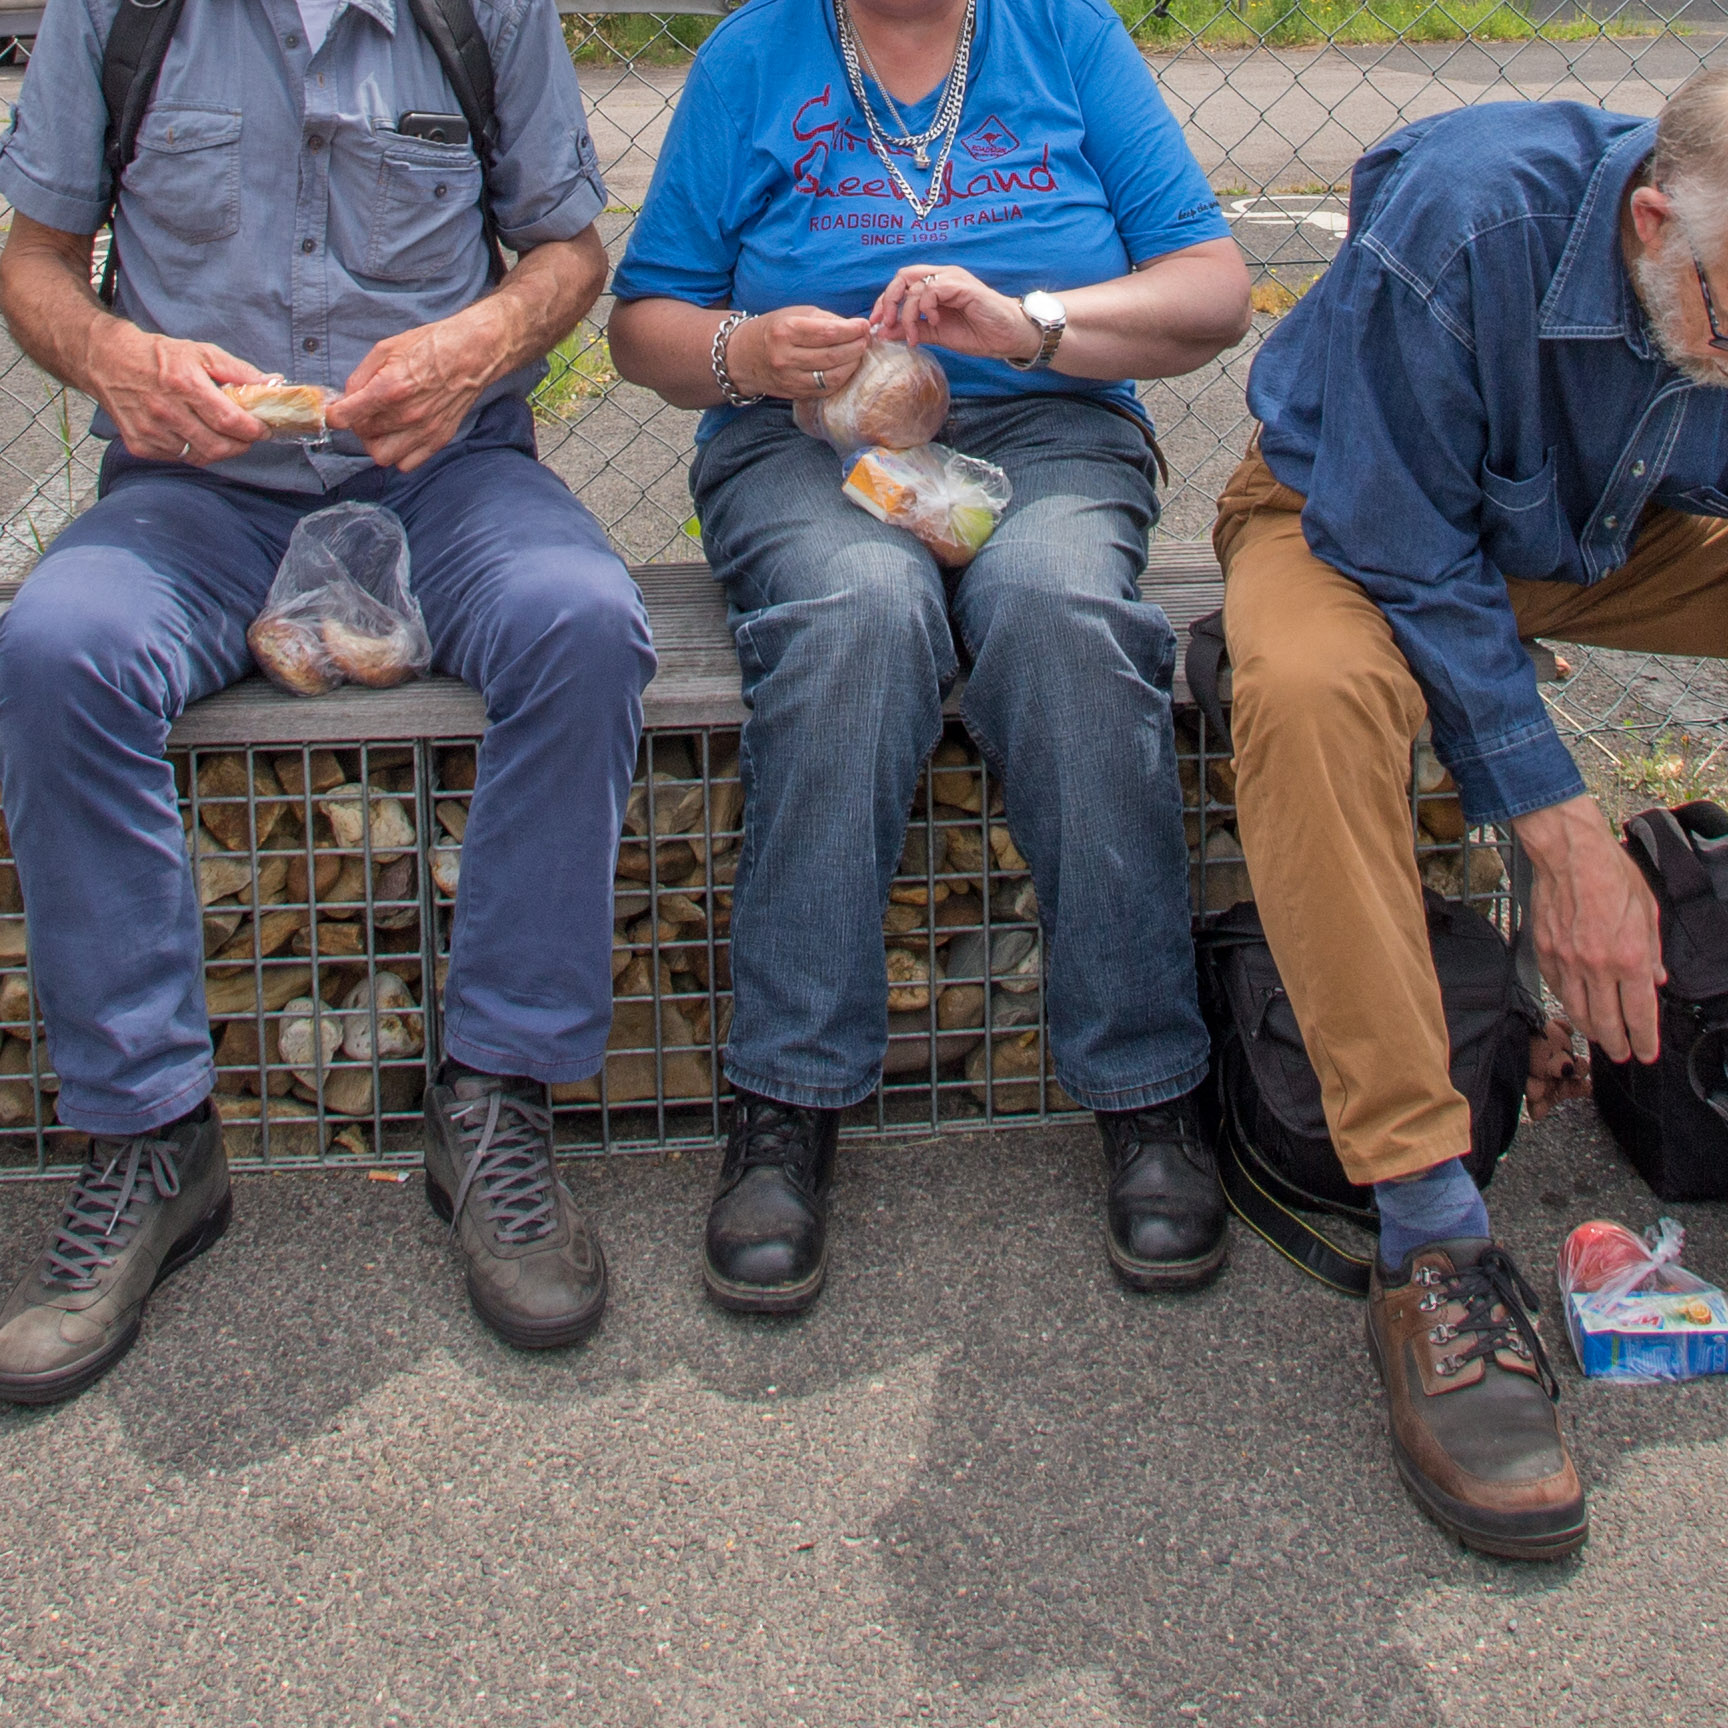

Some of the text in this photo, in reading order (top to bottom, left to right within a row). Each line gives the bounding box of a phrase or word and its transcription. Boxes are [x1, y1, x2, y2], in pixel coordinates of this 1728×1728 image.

[809, 204, 1023, 232] ROADSIGN AUSTRALIA
[861, 232, 948, 246] SINCE 1985
